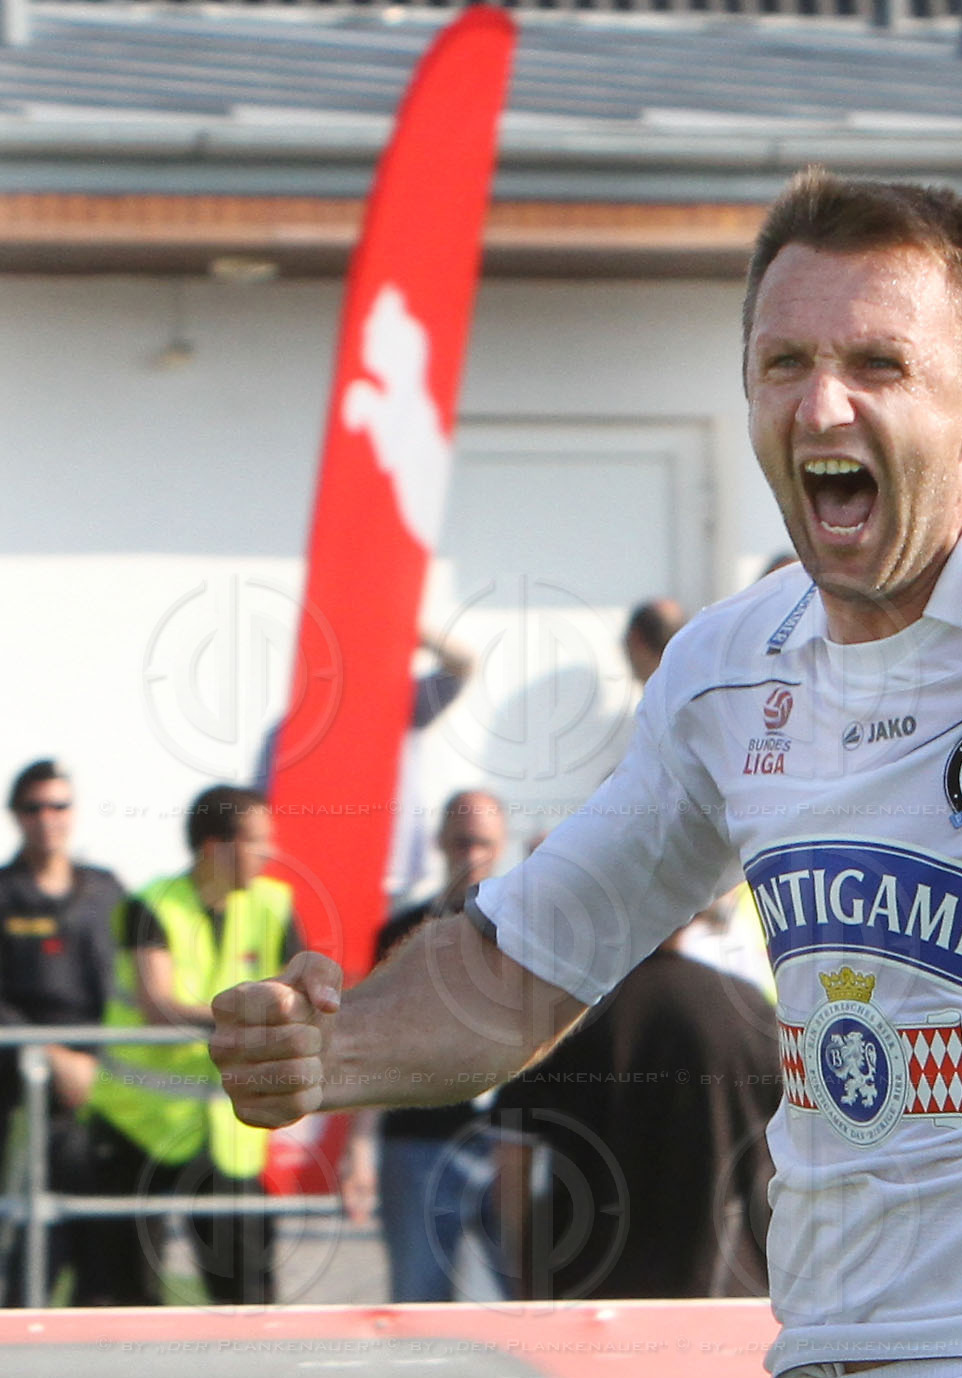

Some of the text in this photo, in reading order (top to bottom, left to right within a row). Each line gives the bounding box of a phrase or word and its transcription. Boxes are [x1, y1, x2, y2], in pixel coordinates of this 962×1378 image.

[867, 715, 917, 744] JAKO
[748, 738, 792, 752] BUNDES
[743, 753, 785, 775] LIGA
